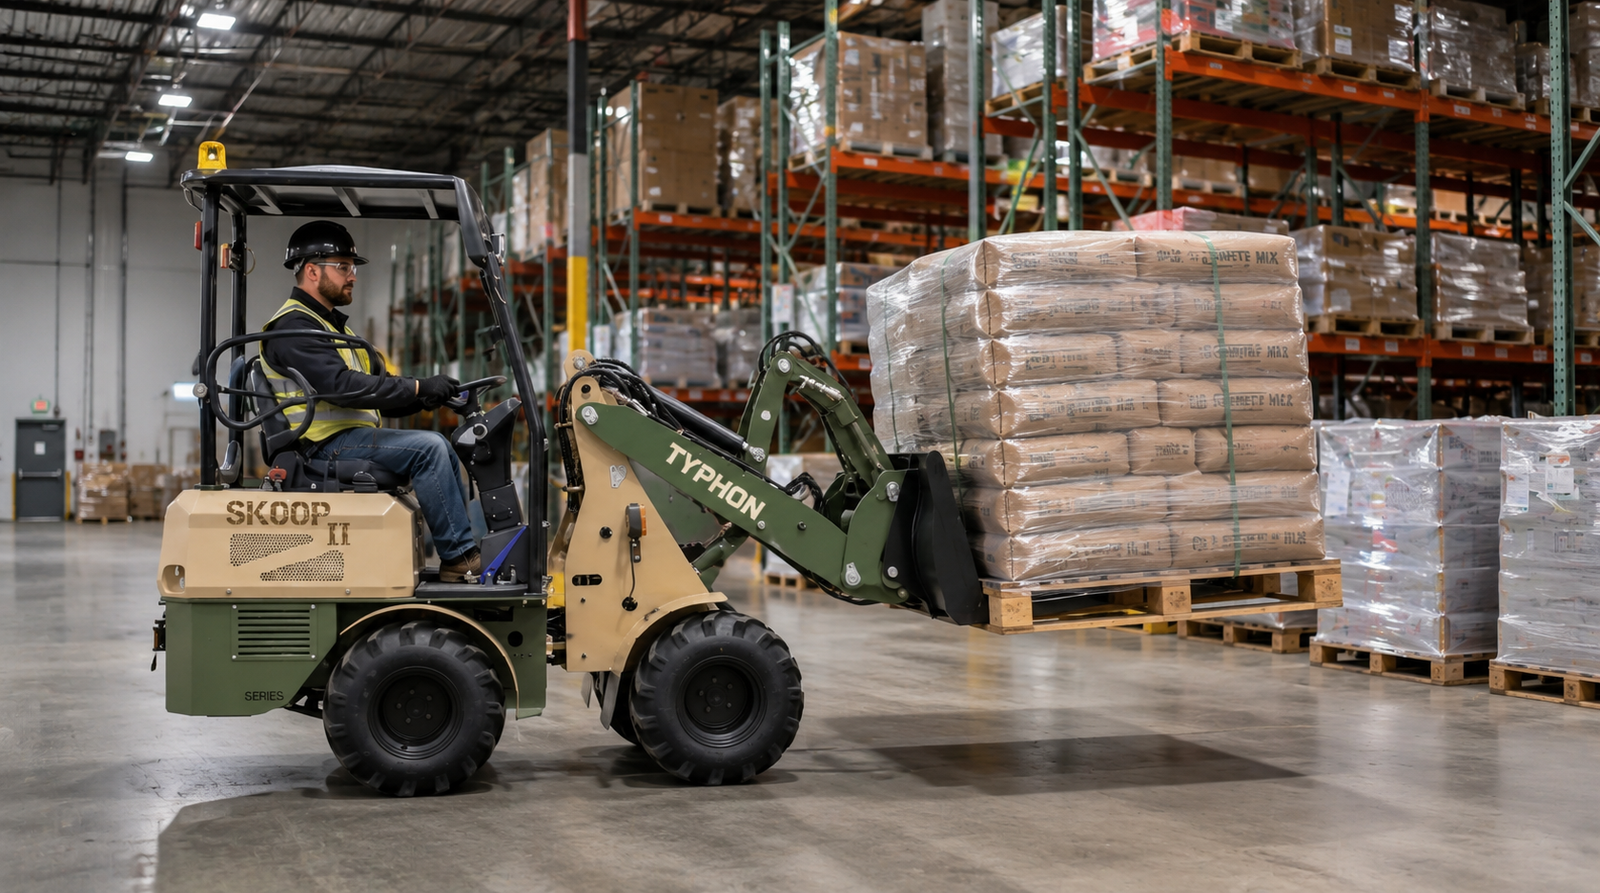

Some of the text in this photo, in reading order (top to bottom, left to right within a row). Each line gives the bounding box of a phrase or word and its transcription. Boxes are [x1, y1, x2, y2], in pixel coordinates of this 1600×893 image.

[1255, 250, 1279, 265] MIX
[666, 442, 766, 521] TYPHON
[226, 500, 331, 526] SKOOP
[327, 522, 351, 546] II
[244, 690, 285, 702] SERIES
